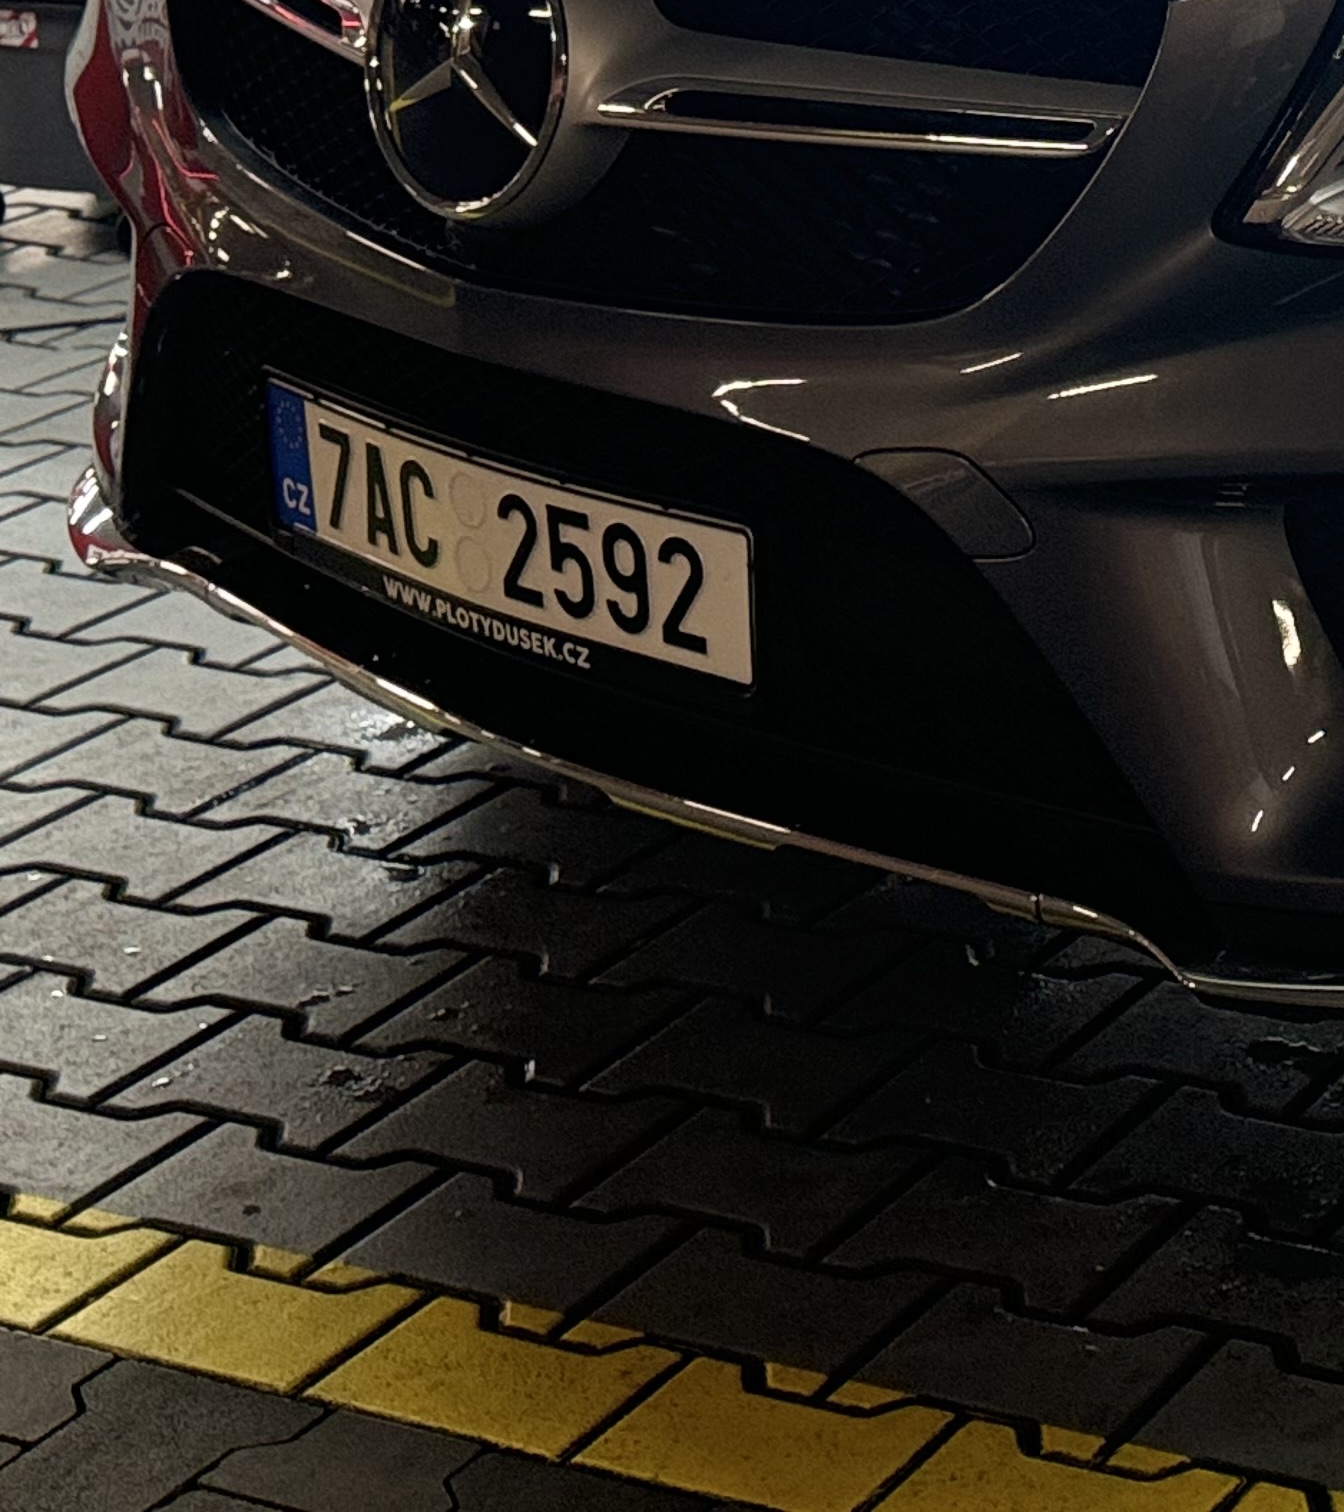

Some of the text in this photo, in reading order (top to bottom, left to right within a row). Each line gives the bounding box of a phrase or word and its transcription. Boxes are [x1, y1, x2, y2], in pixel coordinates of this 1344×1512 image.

[282, 477, 312, 516] CZ
[318, 419, 708, 657] 7AC 2592
[383, 574, 591, 669] WWW.PLOTYDUSEK.CZ
